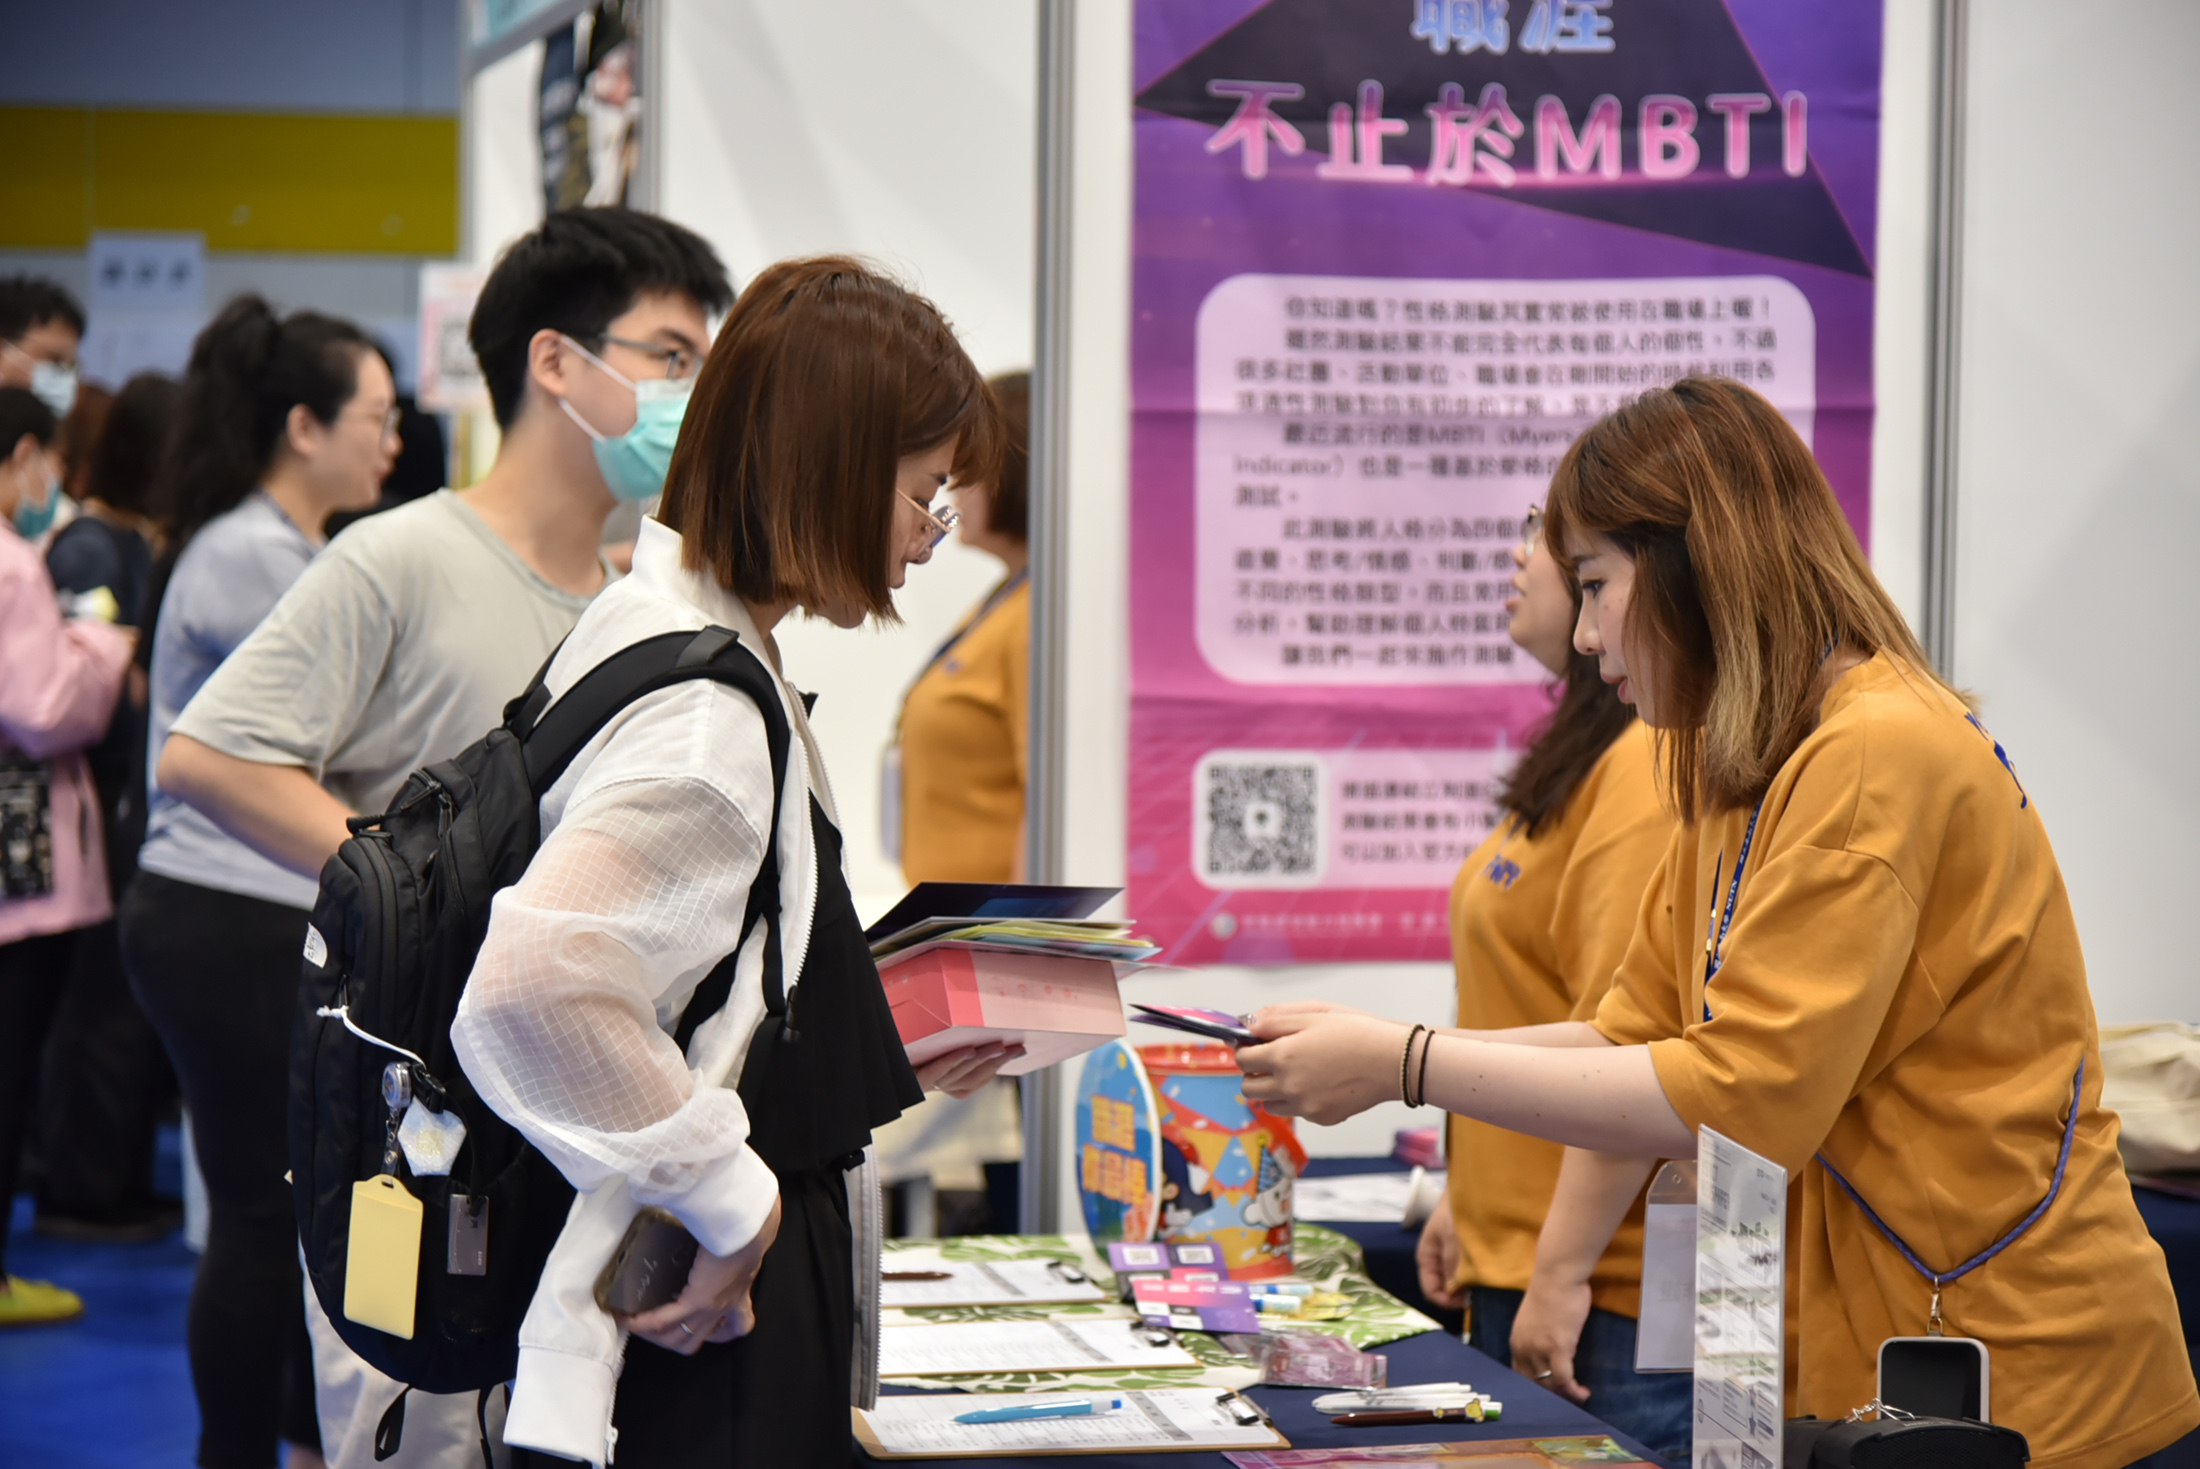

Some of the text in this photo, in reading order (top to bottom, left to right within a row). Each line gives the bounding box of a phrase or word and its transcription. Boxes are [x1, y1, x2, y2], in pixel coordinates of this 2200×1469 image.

[1206, 79, 1809, 187] 不止於MBTI
[1726, 879, 1737, 911] NUTN
